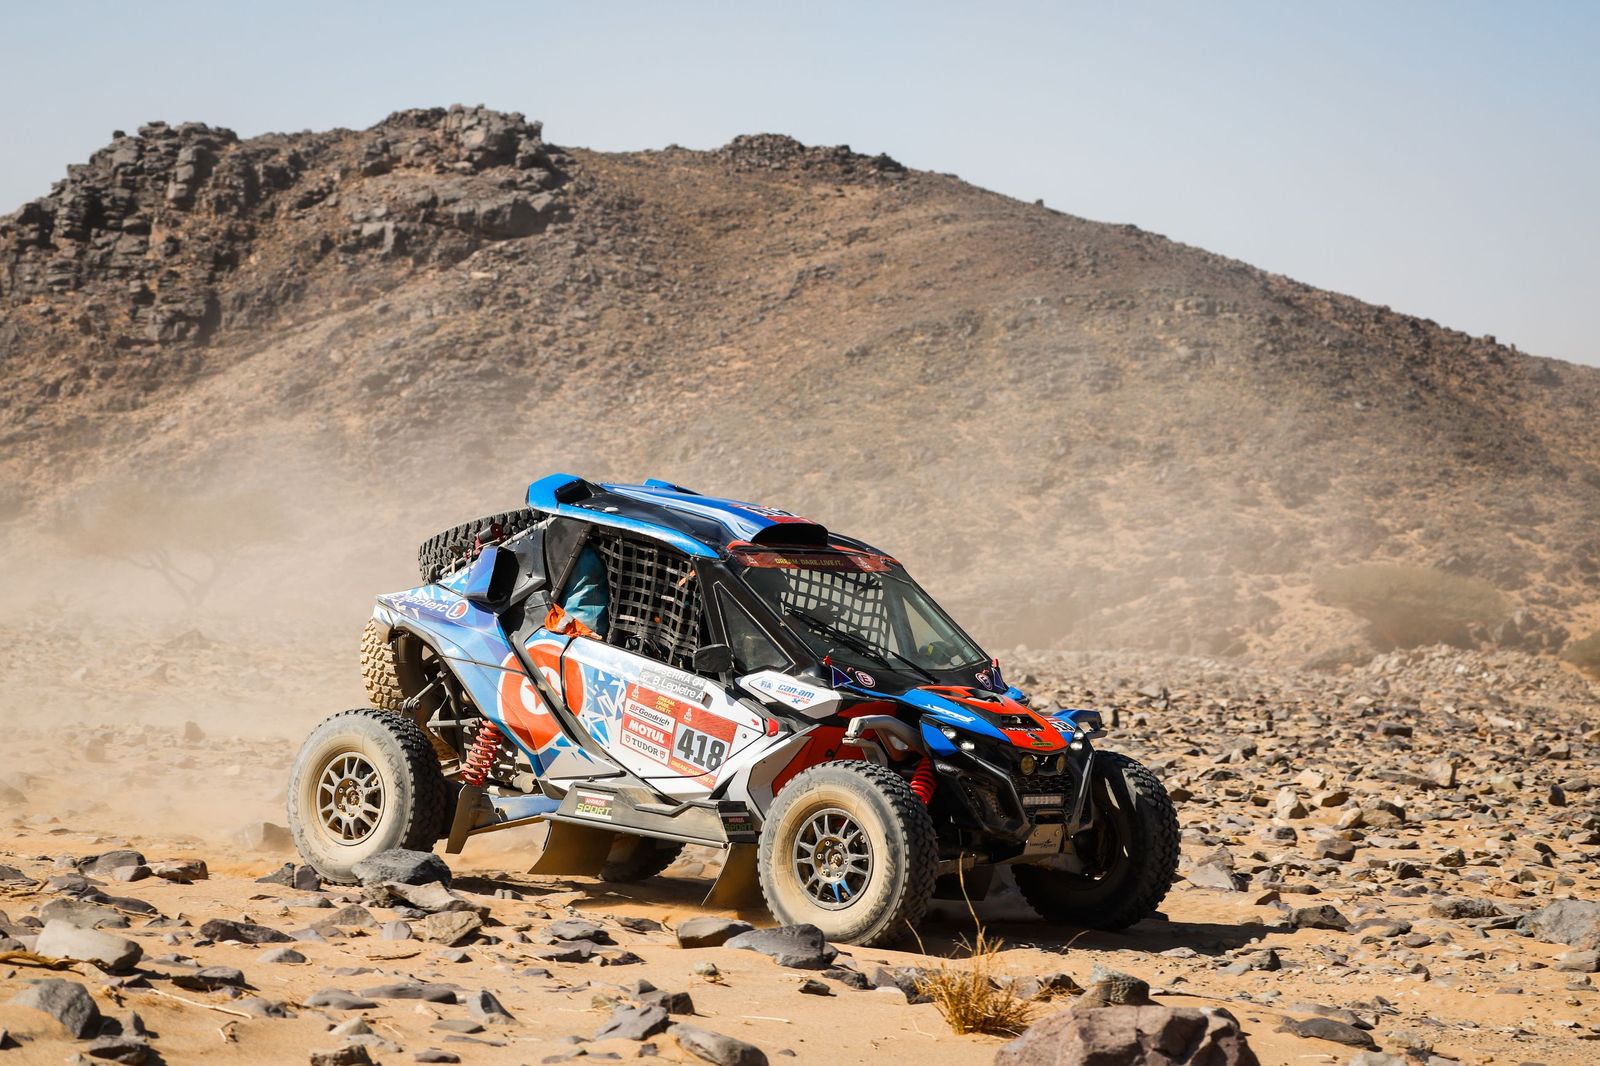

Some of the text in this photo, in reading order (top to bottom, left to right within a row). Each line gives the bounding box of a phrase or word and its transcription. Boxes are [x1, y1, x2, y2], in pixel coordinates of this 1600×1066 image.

[629, 703, 670, 726] BFGoodrich
[628, 719, 666, 744] MOTUL
[631, 737, 659, 757] TUDOR
[677, 728, 726, 772] 418
[576, 803, 613, 816] SPORT
